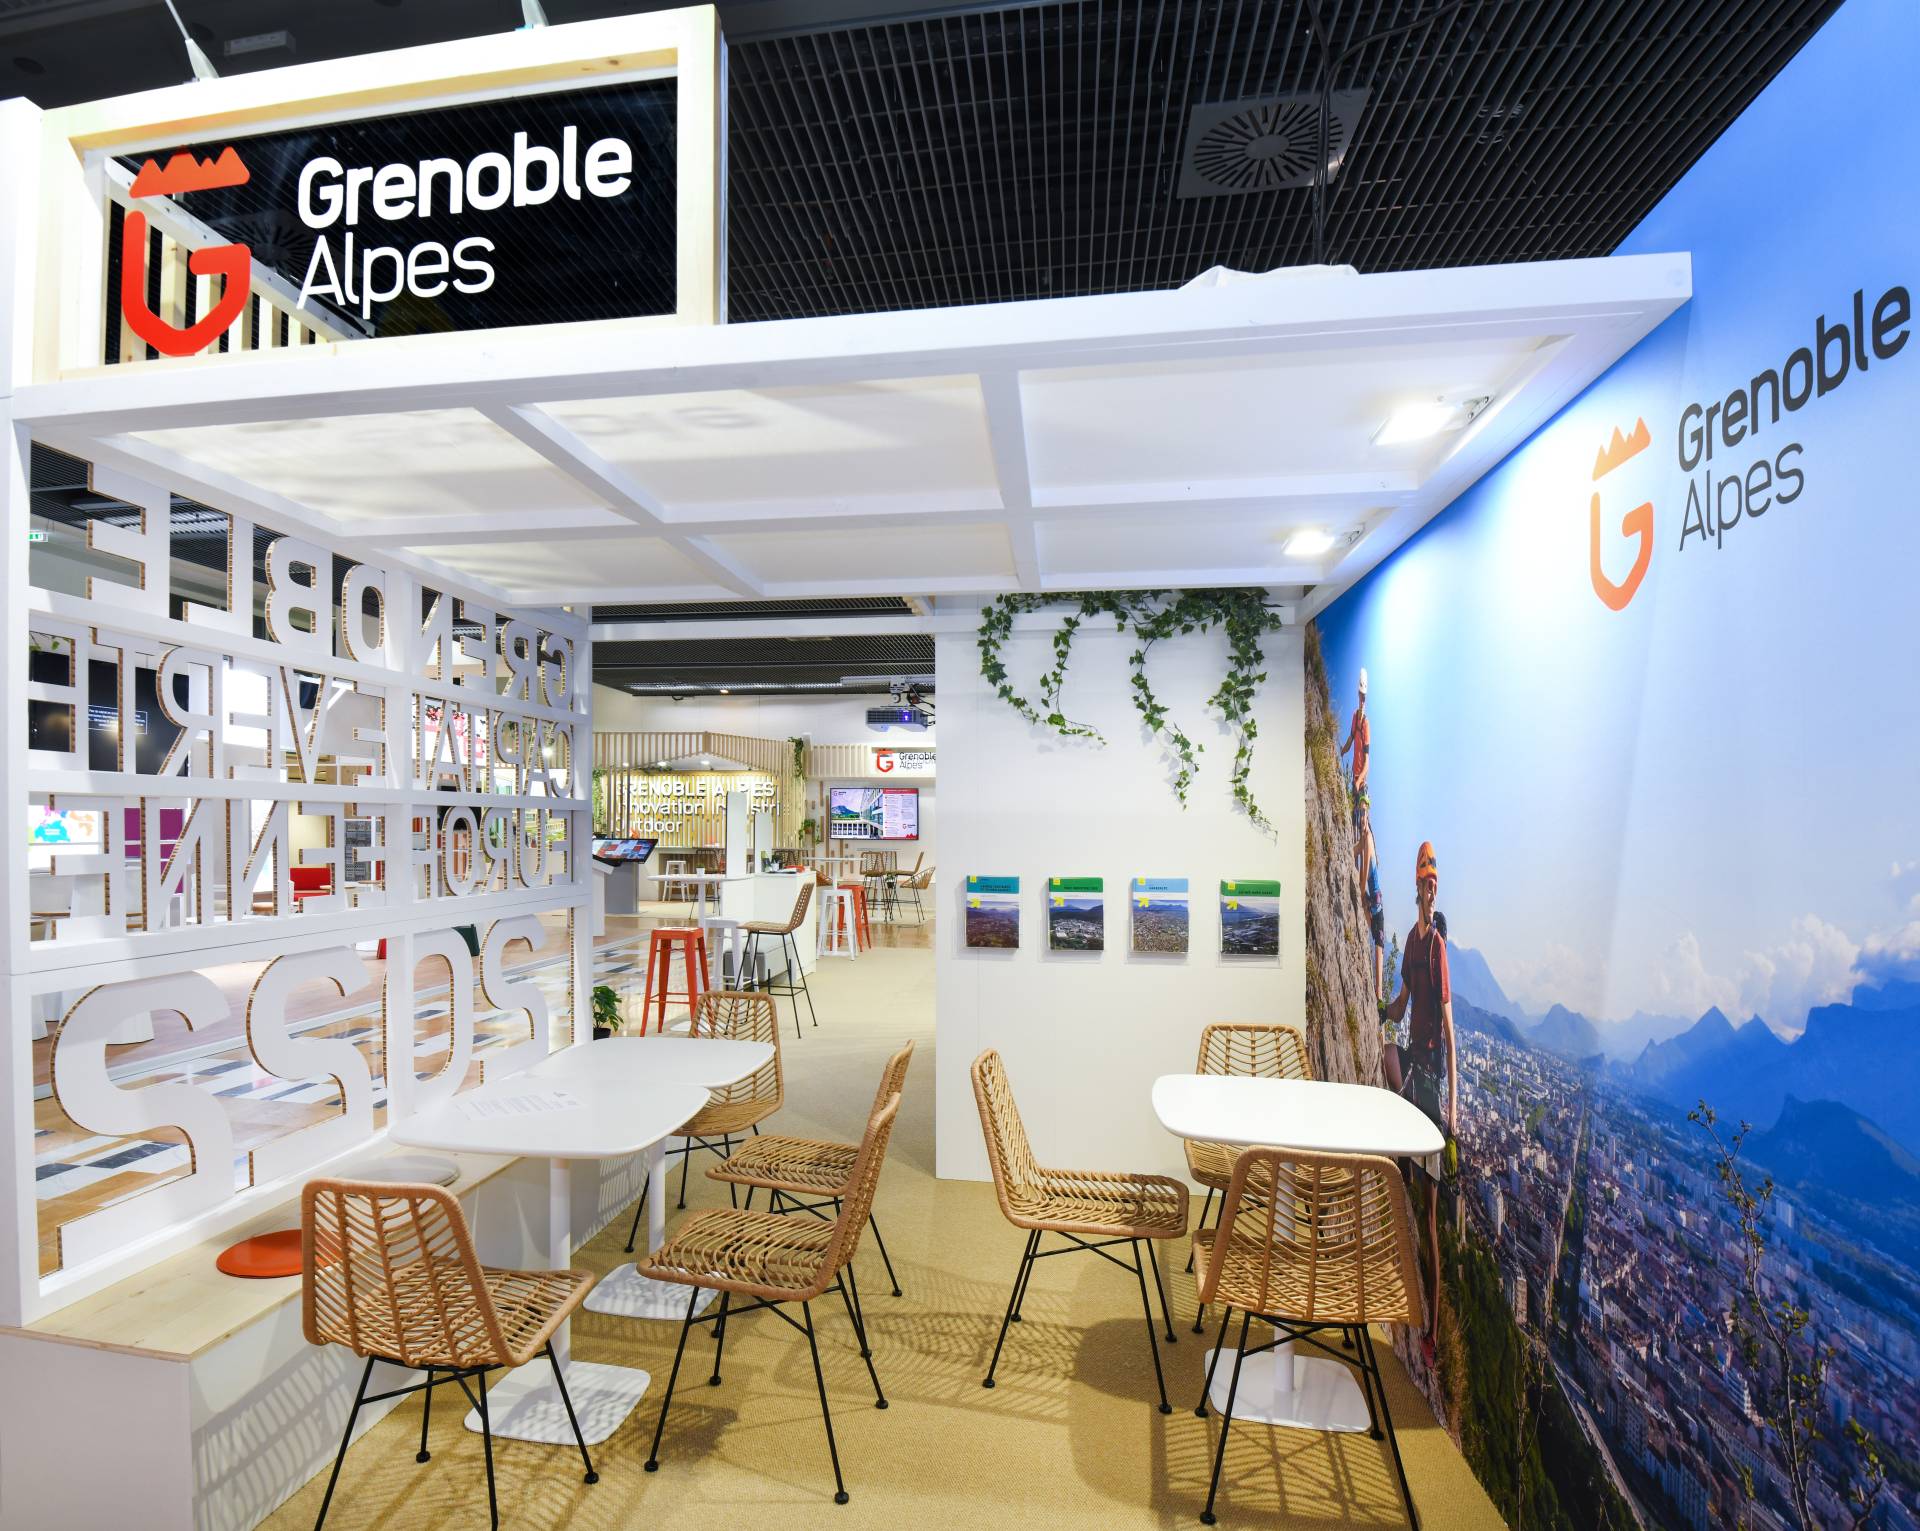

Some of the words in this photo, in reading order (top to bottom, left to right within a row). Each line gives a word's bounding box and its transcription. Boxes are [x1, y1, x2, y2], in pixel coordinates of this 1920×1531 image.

[298, 125, 633, 230] Grenoble
[297, 232, 496, 320] Alpes
[1678, 285, 1911, 472] Grenoble
[1679, 443, 1805, 552] Alpes
[899, 752, 937, 761] Grenoble
